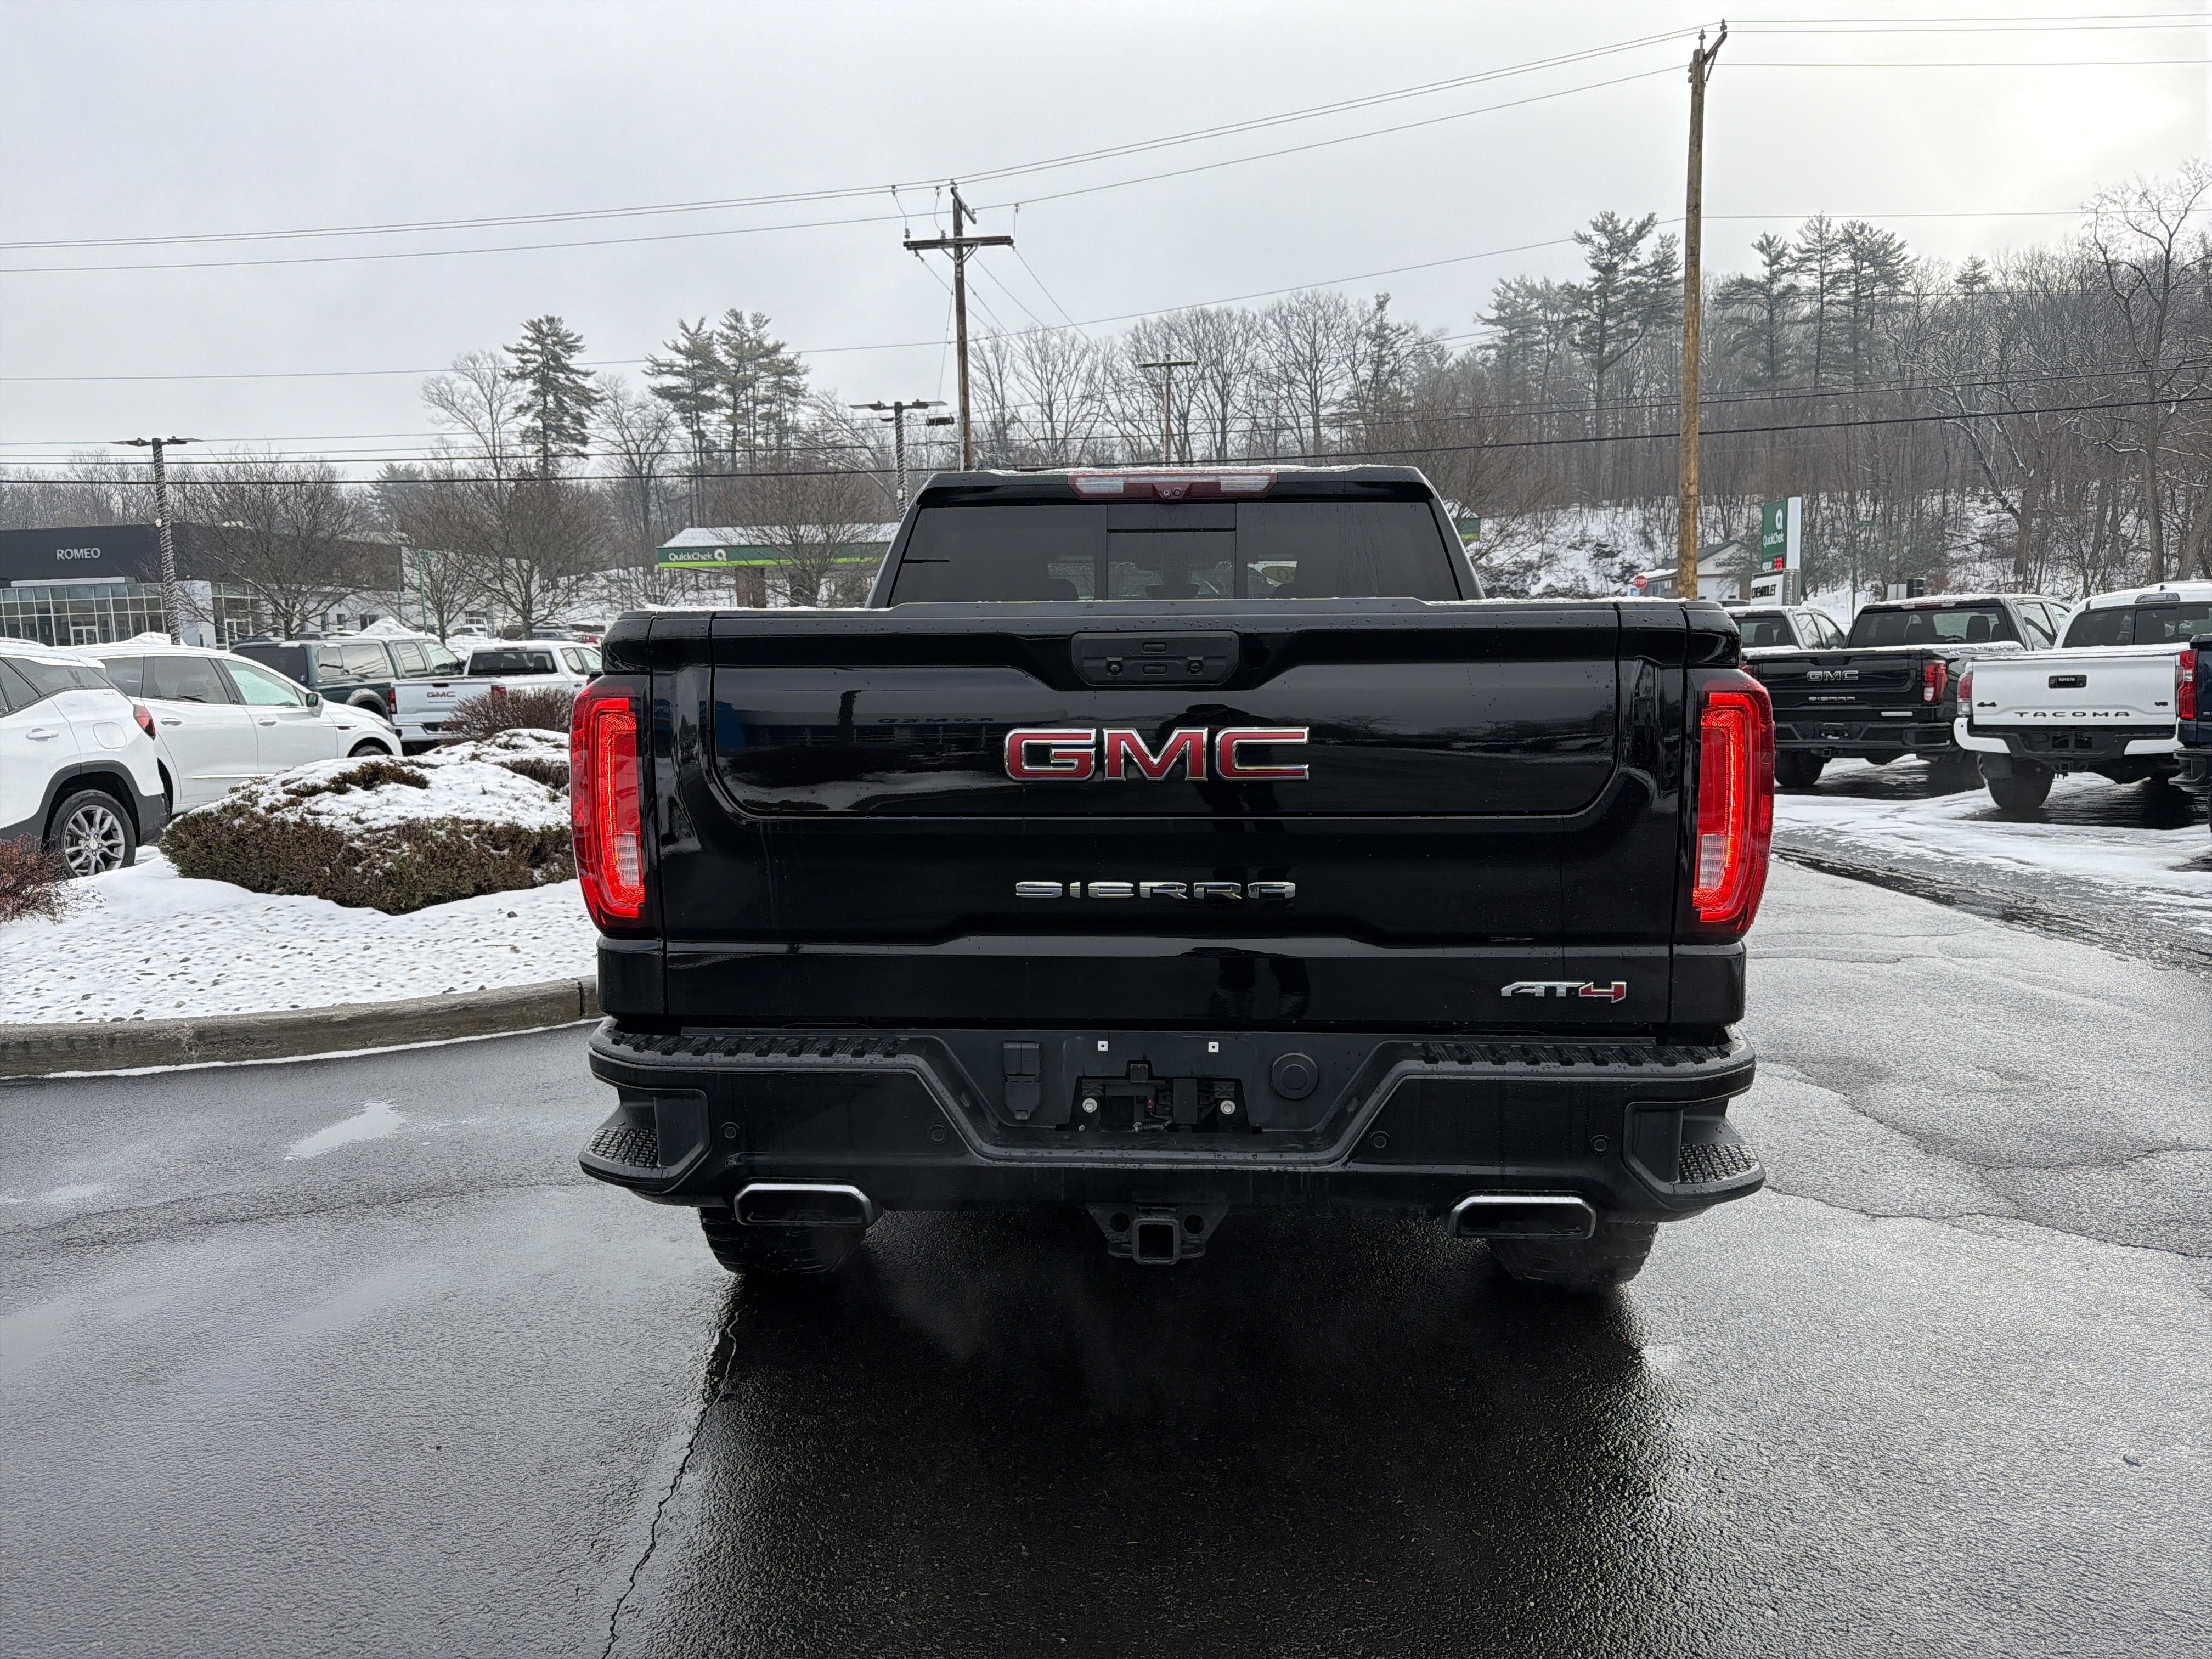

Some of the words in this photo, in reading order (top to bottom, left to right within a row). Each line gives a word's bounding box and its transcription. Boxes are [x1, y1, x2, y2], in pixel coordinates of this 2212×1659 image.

[1763, 531, 1784, 548] QuickChek
[56, 548, 101, 560] ROMEO
[669, 552, 713, 562] QuickChek
[1751, 584, 1777, 599] CHEVROLET
[1807, 670, 1859, 681] GMC
[1004, 726, 1310, 782] GMC
[1015, 881, 1296, 899] SIERRA
[1501, 981, 1627, 1004] AT4
